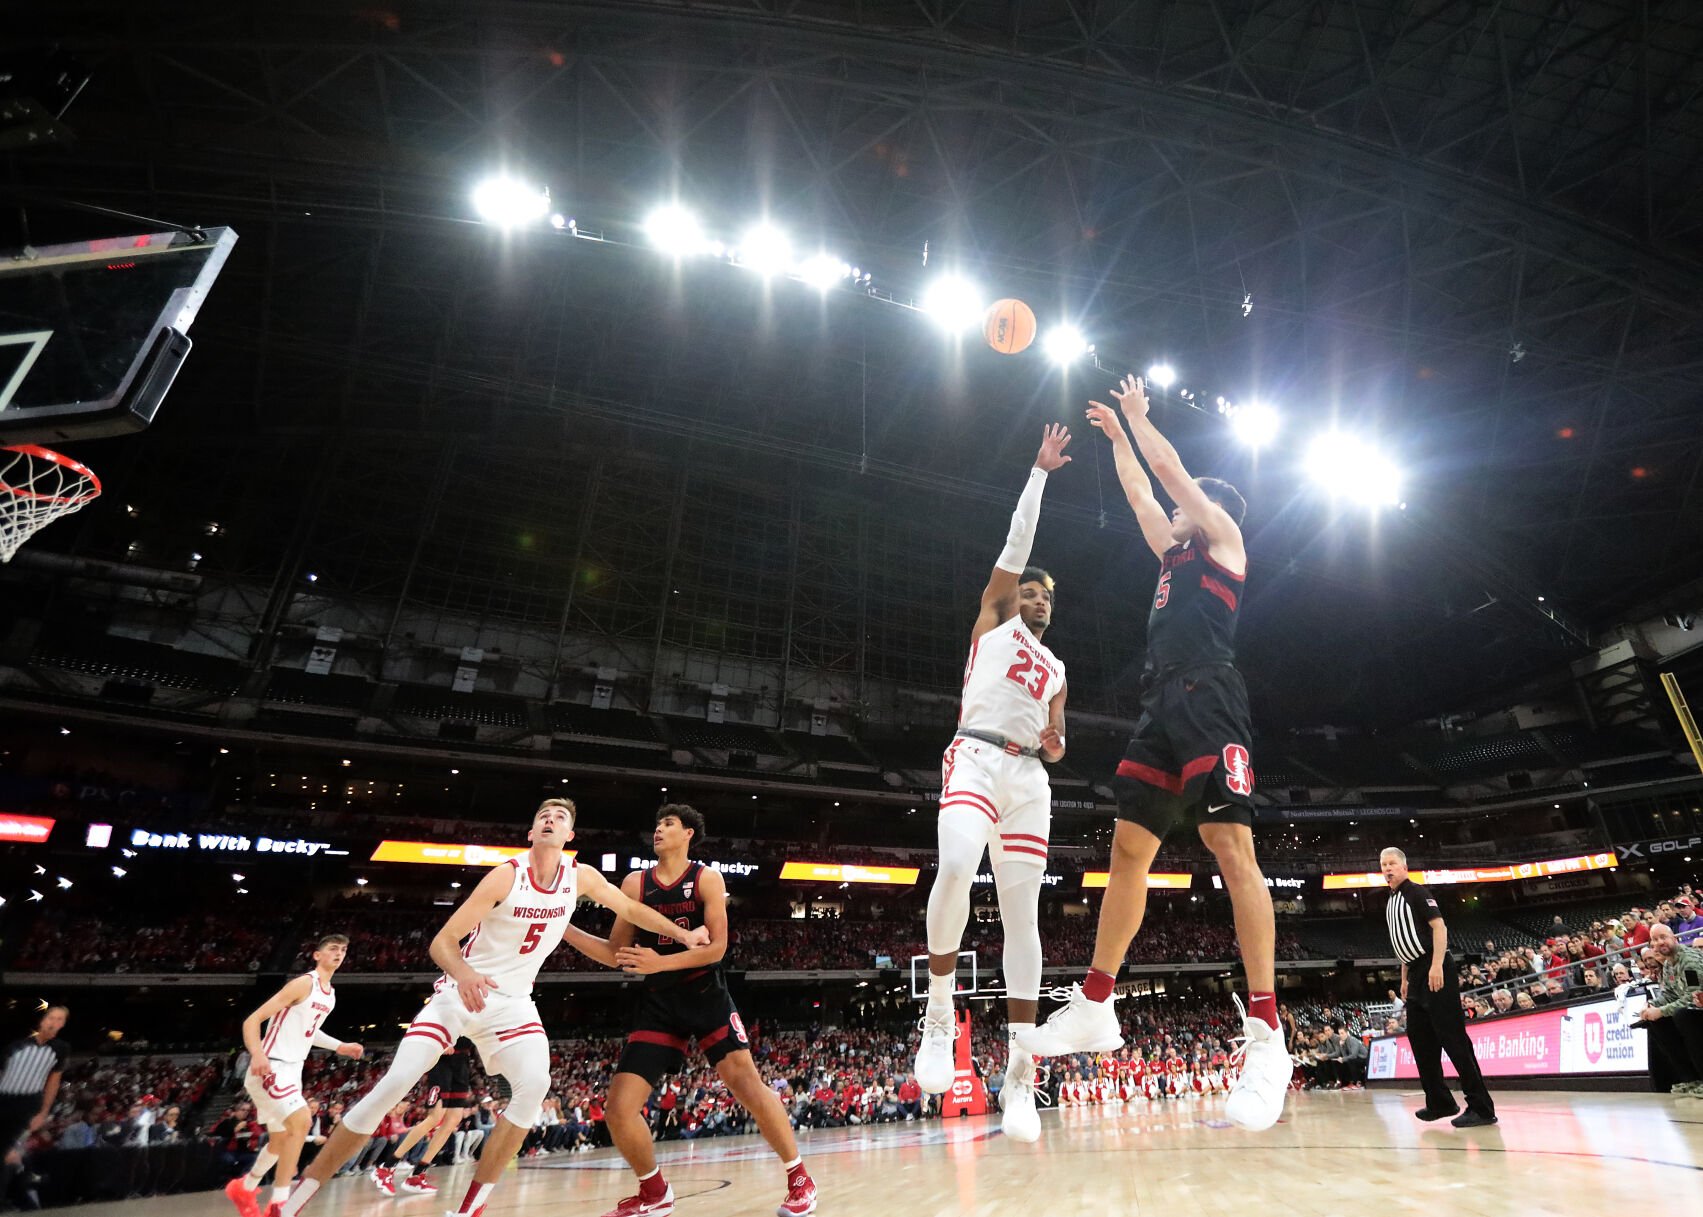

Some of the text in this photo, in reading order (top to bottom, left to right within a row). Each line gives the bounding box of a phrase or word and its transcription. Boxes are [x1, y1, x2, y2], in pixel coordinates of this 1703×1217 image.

[1012, 629, 1059, 678] WISCONSIN
[1006, 649, 1050, 700] 23
[1290, 809, 1332, 818] Northwestern
[1332, 808, 1355, 817] Mutual
[131, 829, 192, 848] Bank
[198, 833, 251, 851] With
[1617, 837, 1702, 860] X GOLF
[630, 856, 659, 869] Ban
[973, 873, 994, 883] ank
[513, 906, 566, 919] WISCONSIN
[519, 923, 547, 955] 5
[1114, 982, 1149, 996] AUSAGE
[305, 1013, 321, 1038] 3
[1606, 1013, 1620, 1024] uw
[1606, 1024, 1634, 1042] credit
[1499, 1031, 1549, 1061] Banking.
[1606, 1042, 1635, 1060] union
[1400, 1047, 1413, 1064] The
[952, 1096, 973, 1104] Aurora
